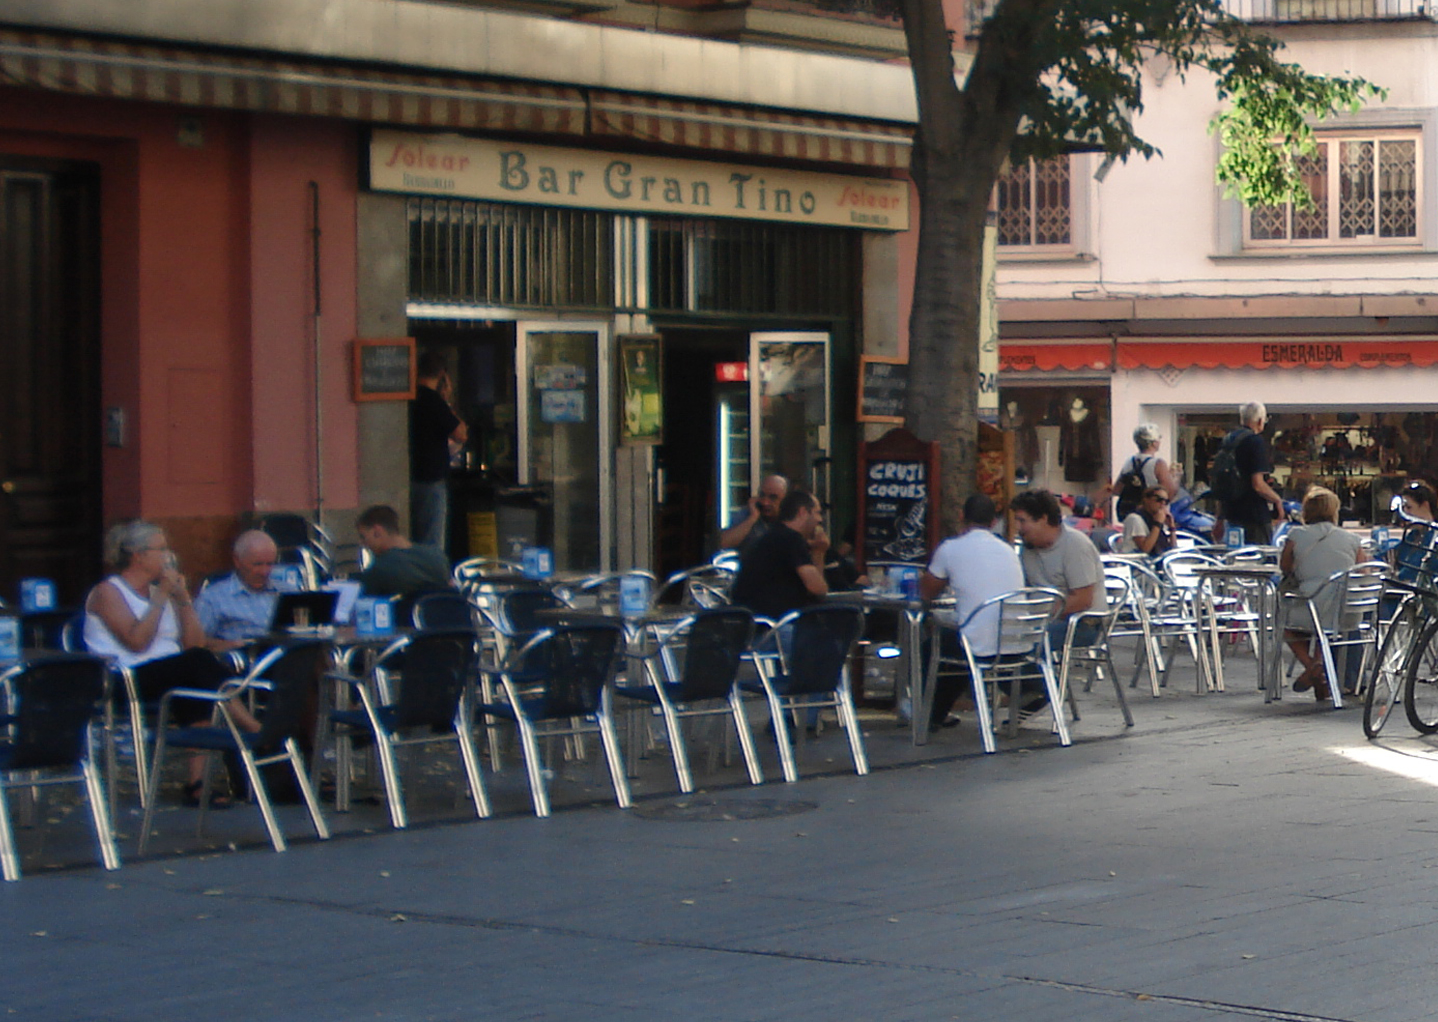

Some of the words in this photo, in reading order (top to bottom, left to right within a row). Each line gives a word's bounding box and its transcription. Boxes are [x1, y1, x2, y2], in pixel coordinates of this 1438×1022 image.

[497, 150, 584, 195] Bar
[604, 160, 711, 206] Gran
[729, 172, 816, 215] Tino
[1262, 344, 1344, 363] ESMERALDA
[867, 484, 926, 498] COQUES
